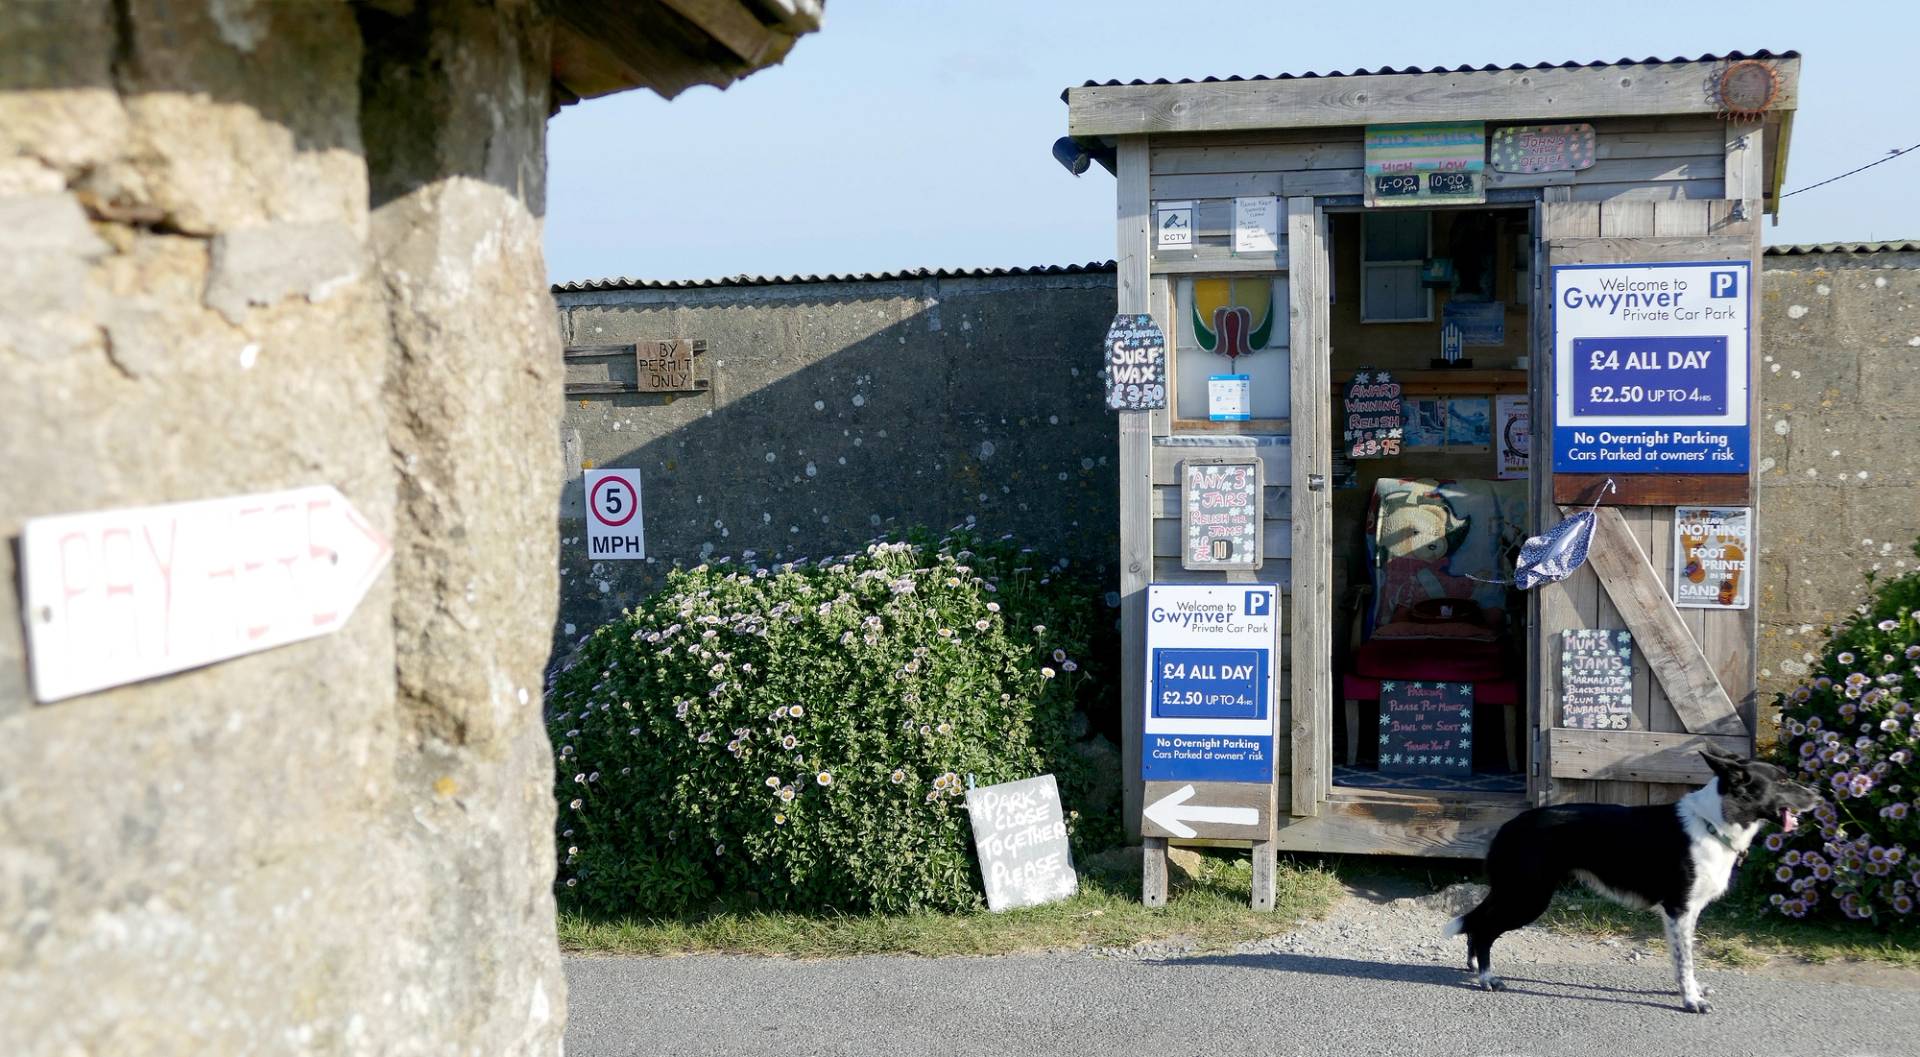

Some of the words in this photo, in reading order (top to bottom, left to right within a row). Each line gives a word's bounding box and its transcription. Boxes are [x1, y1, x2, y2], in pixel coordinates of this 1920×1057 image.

[1520, 133, 1565, 148] JOHN'S
[1382, 162, 1413, 172] HIGH
[1439, 160, 1468, 171] LOW
[1164, 233, 1187, 241] CCTV
[1600, 276, 1669, 292] Welcome
[1674, 278, 1688, 292] to
[1716, 273, 1733, 297] P
[1564, 287, 1683, 314] Gwynver
[1623, 308, 1669, 320] Private
[1674, 308, 1700, 320] Car
[1705, 305, 1736, 320] Park
[659, 343, 678, 358] BY
[1112, 341, 1158, 364] SURF
[640, 359, 692, 373] PERMIT
[1590, 350, 1620, 370] £4
[1626, 352, 1660, 370] ALL
[1668, 350, 1712, 370] DAY
[651, 373, 687, 388] ONLY
[1112, 365, 1155, 384] WAX
[1350, 384, 1400, 398] AWARD
[1590, 386, 1643, 402] £2.50
[1648, 389, 1665, 402] UP
[1667, 389, 1686, 402] TO
[1344, 399, 1400, 414] WINNING
[1350, 414, 1400, 429] RELISH
[1574, 432, 1595, 444] No
[1600, 430, 1669, 446] Overnight
[1674, 431, 1728, 447] Parking
[1568, 448, 1597, 460] Cars
[1600, 448, 1642, 460] Parked
[1645, 449, 1658, 460] at
[1712, 448, 1735, 460] risk
[1192, 471, 1226, 489] ANY
[1234, 469, 1246, 489] 3
[606, 488, 622, 514] 5
[1202, 492, 1248, 509] JARS
[1208, 526, 1244, 537] JAMS
[1680, 524, 1746, 536] NOTHING
[592, 536, 640, 553] MPH
[1690, 548, 1726, 558] FOOT
[1702, 560, 1746, 570] PRINTS
[1720, 572, 1734, 580] THE
[1680, 584, 1720, 596] SAND
[1176, 600, 1224, 612] Welcome
[1227, 602, 1236, 612] to
[1250, 592, 1265, 614] P
[1152, 608, 1233, 628] Gwynver
[1192, 624, 1224, 632] Private
[1226, 624, 1244, 632] Car
[1248, 623, 1268, 632] Park
[1574, 656, 1622, 670] JAMS
[1163, 663, 1186, 679] £4
[1190, 664, 1216, 680] ALL
[1222, 665, 1254, 680] DAY
[1162, 691, 1202, 705] £2.50
[1206, 695, 1218, 706] UP
[1220, 695, 1234, 706] TO
[1568, 694, 1594, 704] PLUM
[1157, 738, 1170, 748] No
[1174, 738, 1220, 750] Overnight
[1223, 739, 1260, 751] Parking
[1152, 750, 1172, 759] Cars
[1174, 750, 1202, 760] Parked
[1204, 751, 1213, 760] at
[1248, 752, 1264, 760] risk
[984, 787, 1036, 822] PARK
[995, 803, 1050, 830] CLOSE
[976, 820, 1067, 862] TOGETHER
[990, 852, 1060, 890] PLEASE
